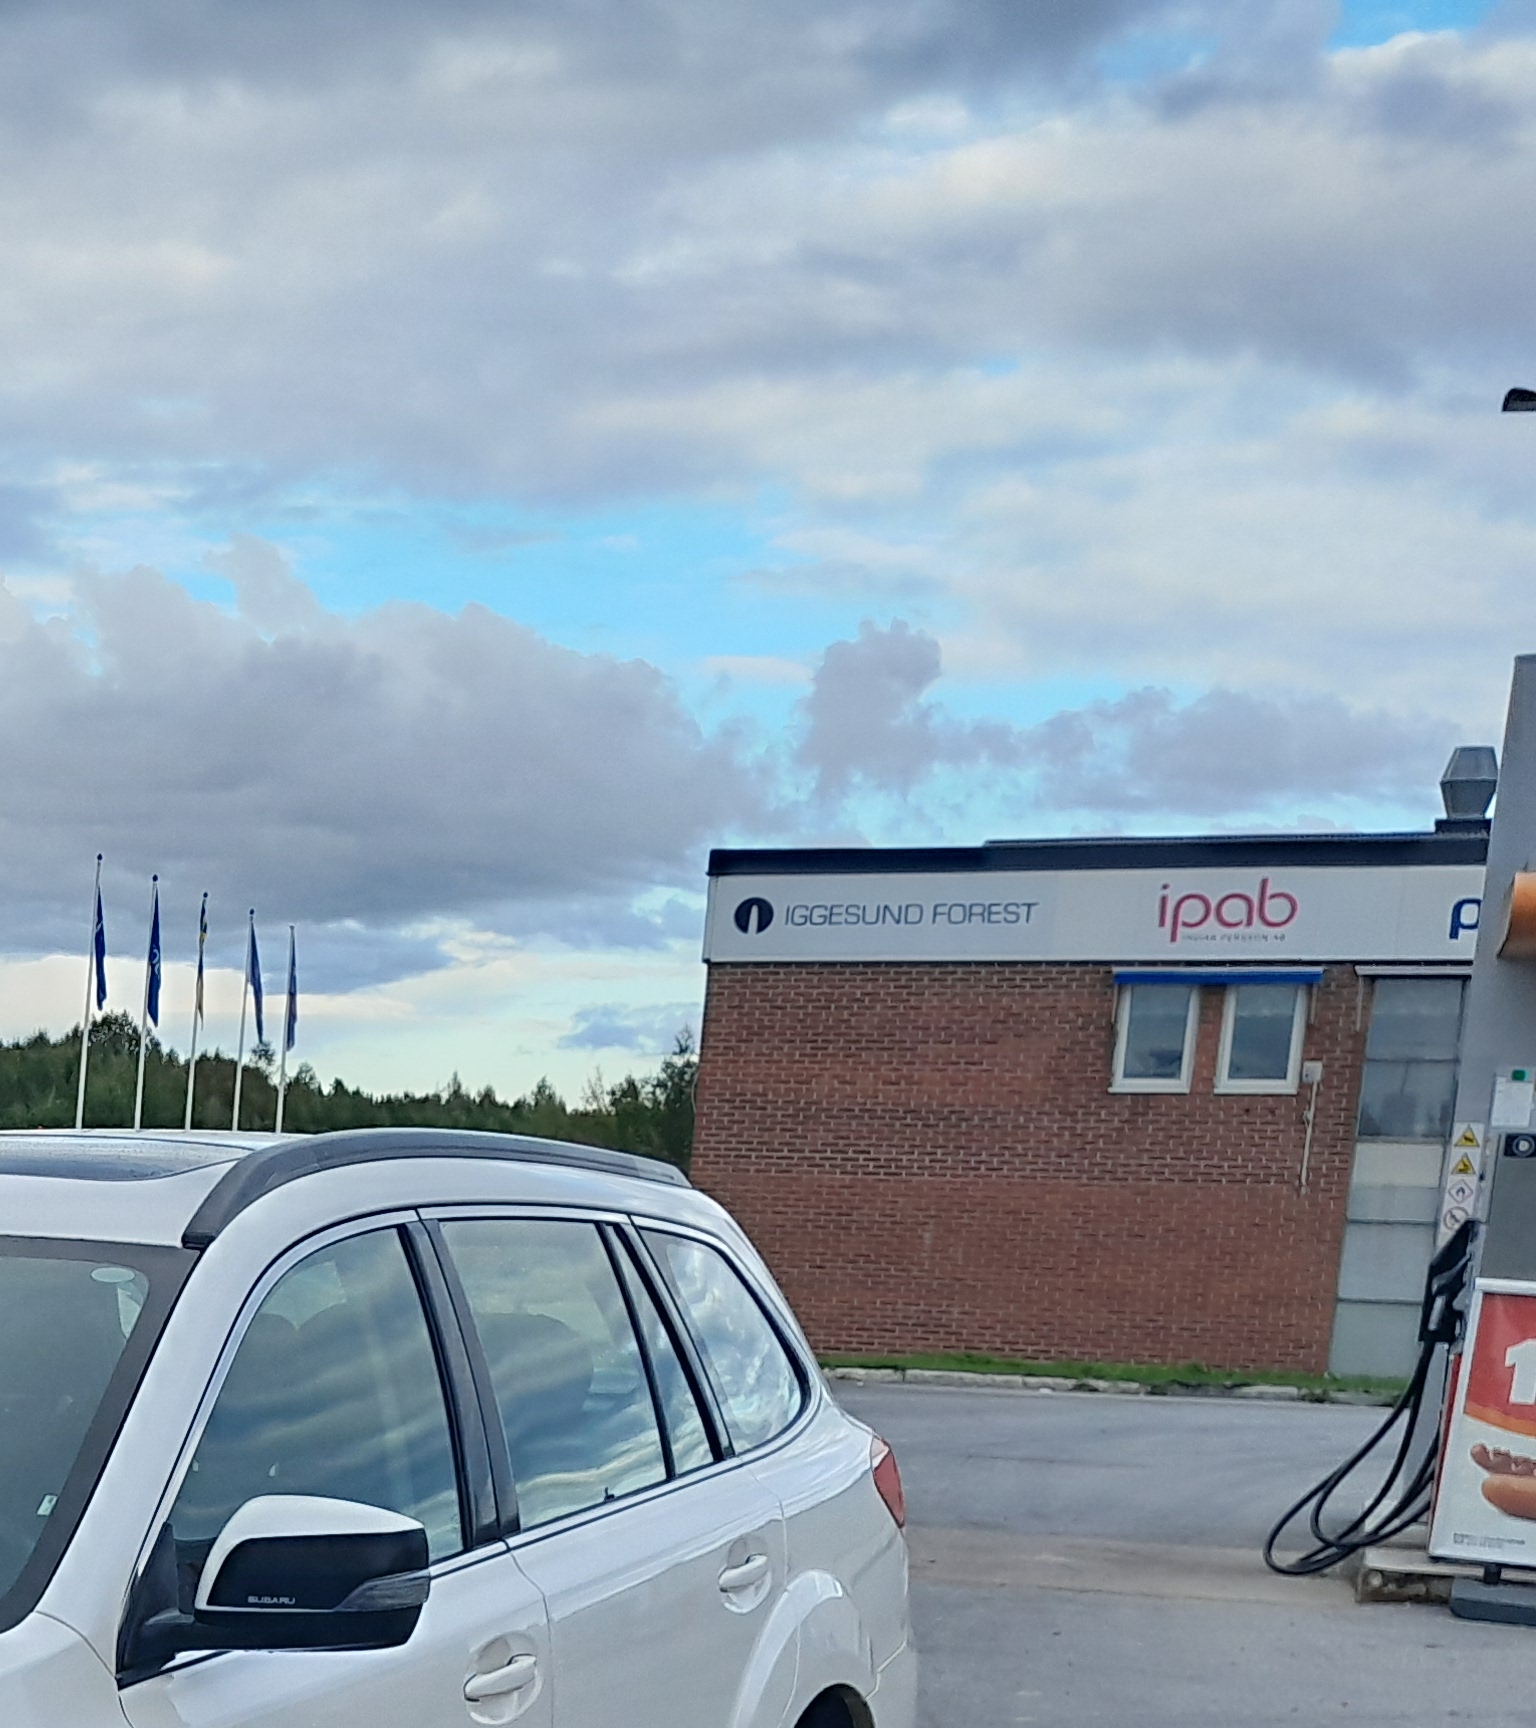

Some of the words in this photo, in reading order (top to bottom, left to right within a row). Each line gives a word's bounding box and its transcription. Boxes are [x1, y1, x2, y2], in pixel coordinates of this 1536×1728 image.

[784, 903, 924, 926] IGGESUND
[931, 902, 1041, 925] FOREST
[1158, 877, 1299, 943] ipab
